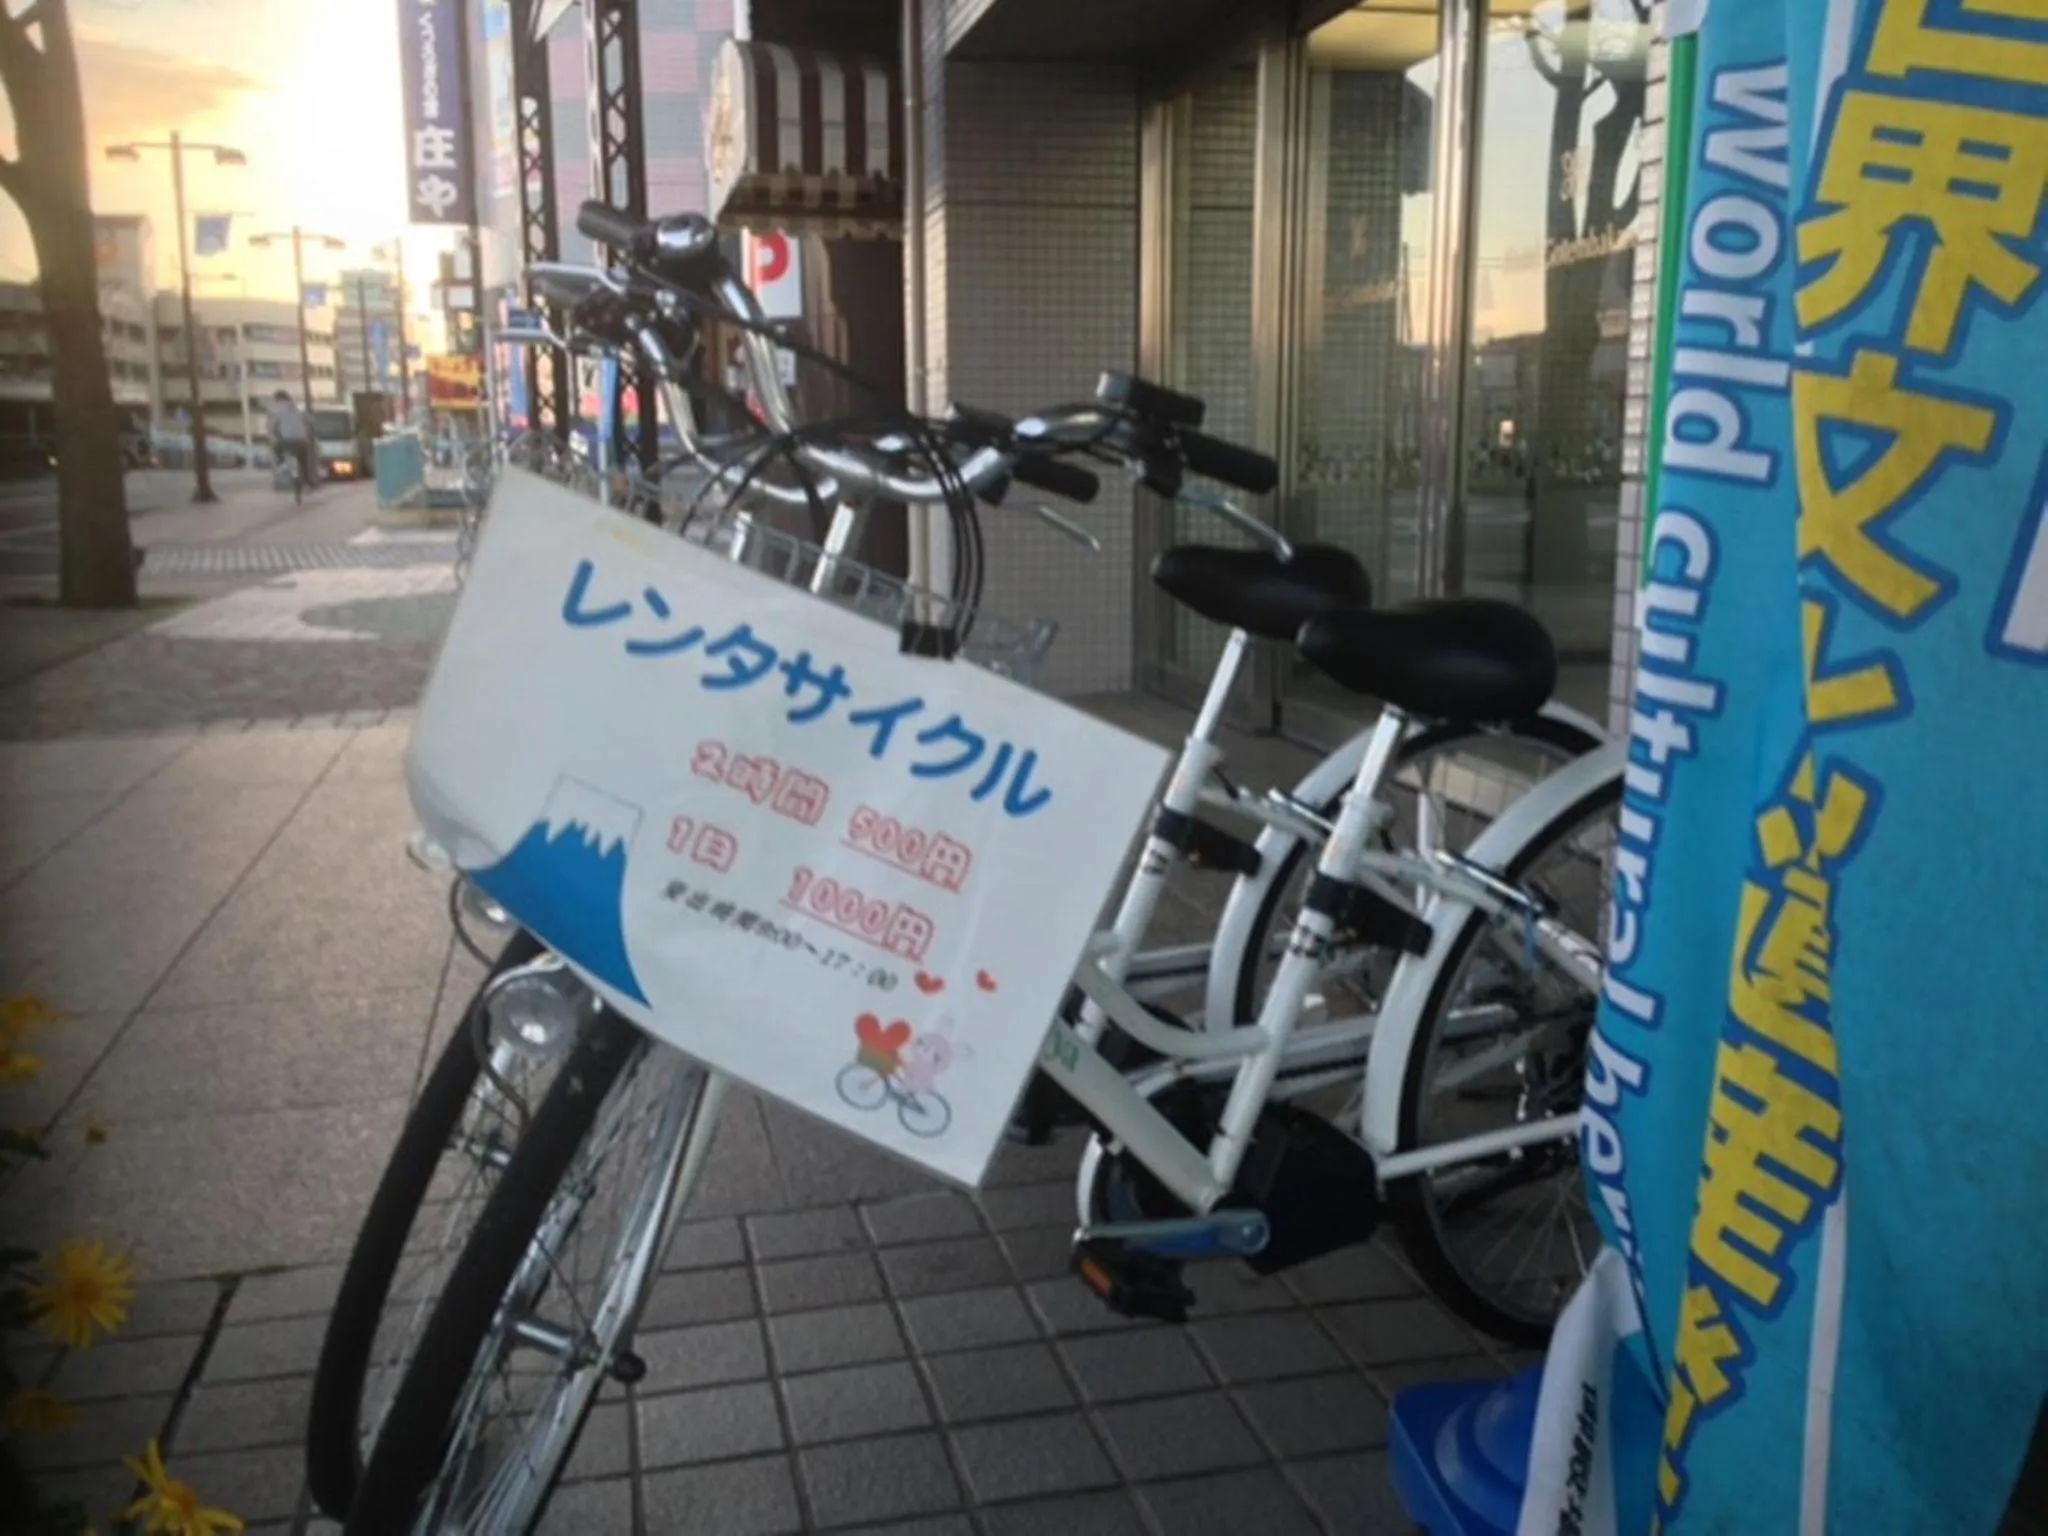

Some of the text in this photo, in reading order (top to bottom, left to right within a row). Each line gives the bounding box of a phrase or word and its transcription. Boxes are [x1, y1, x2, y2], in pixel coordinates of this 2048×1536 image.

[413, 124, 459, 218] 庄や
[561, 558, 1053, 818] レンタサイクル
[665, 816, 936, 962] 1日 1000円
[690, 740, 973, 893] 2時間 500円
